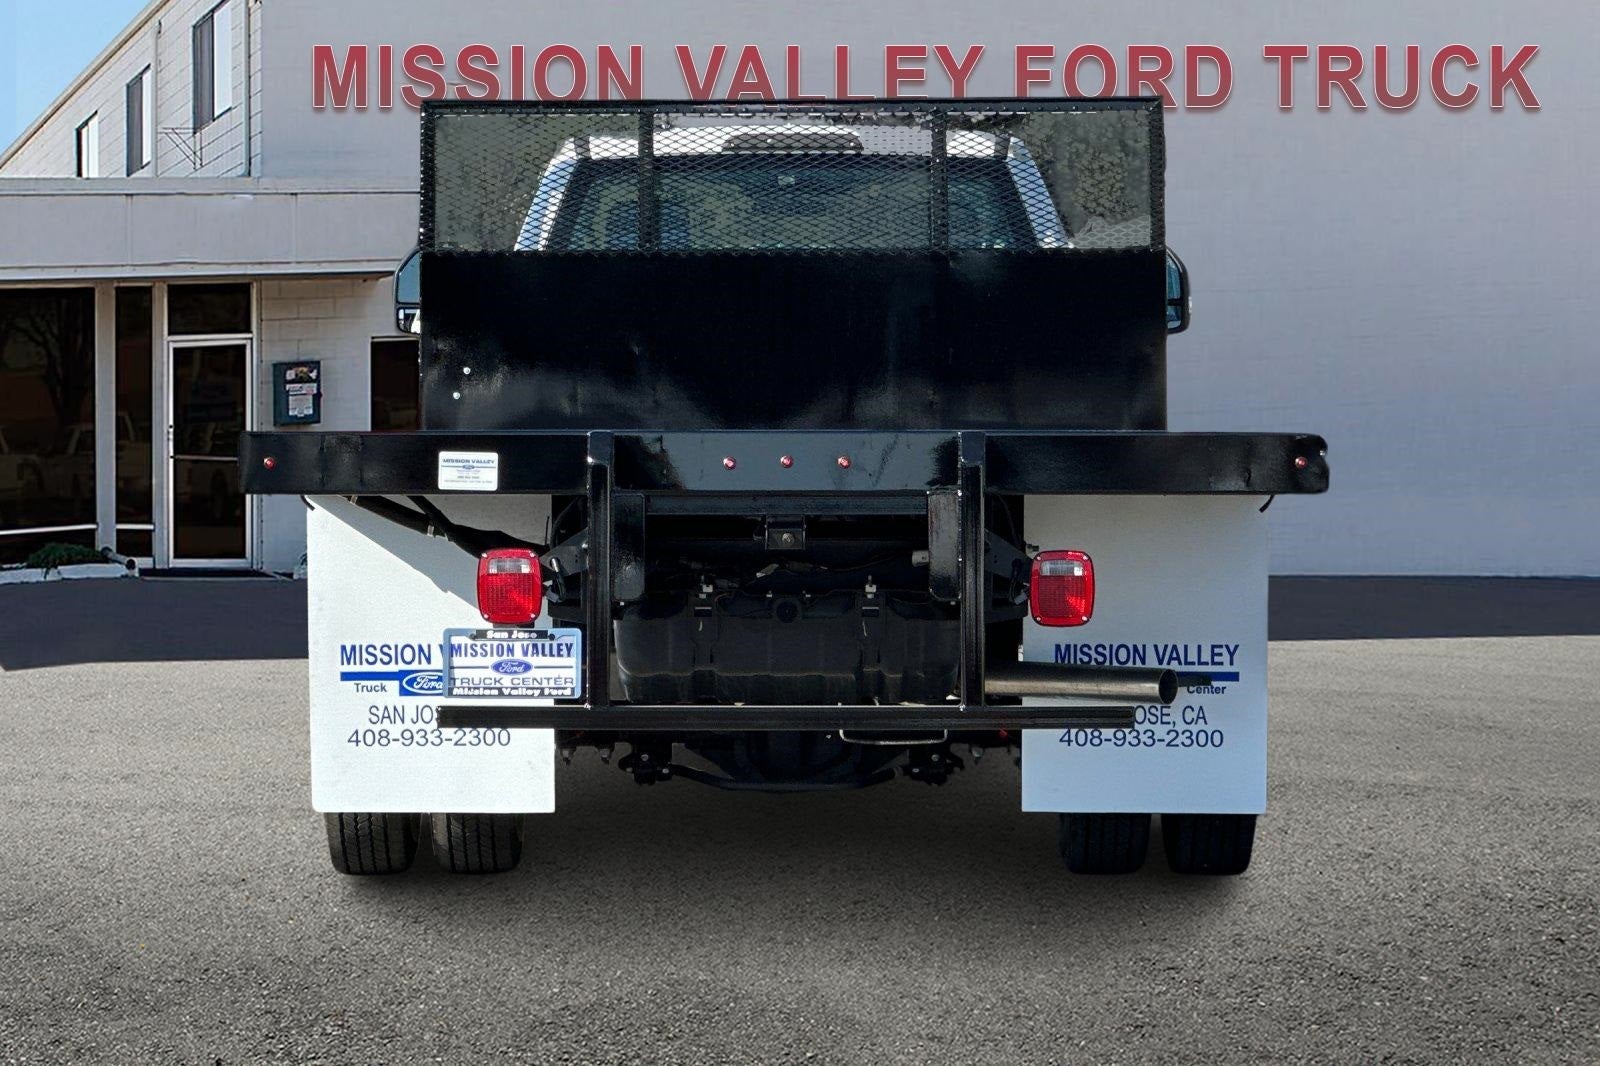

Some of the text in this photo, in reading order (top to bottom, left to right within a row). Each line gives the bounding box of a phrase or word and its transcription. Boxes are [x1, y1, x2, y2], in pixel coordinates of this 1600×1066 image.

[312, 44, 1541, 108] MISSION VALLEY FORD TRUCK
[486, 630, 508, 639] San
[340, 644, 432, 666] MISSION
[451, 643, 515, 658] MISSION
[521, 643, 574, 658] VALLEY
[1054, 644, 1240, 666] MISSION VALLEY
[499, 660, 525, 674] Ford
[354, 682, 387, 693] Truck
[451, 677, 575, 686] TRUCK CENTER
[1187, 684, 1227, 695] Center
[453, 687, 571, 697] Mission Valley Ford
[368, 705, 405, 725] SAN
[1134, 705, 1208, 728] OSE, CA
[347, 729, 511, 747] 408-933-2300
[1059, 729, 1224, 748] 408-933-2300
